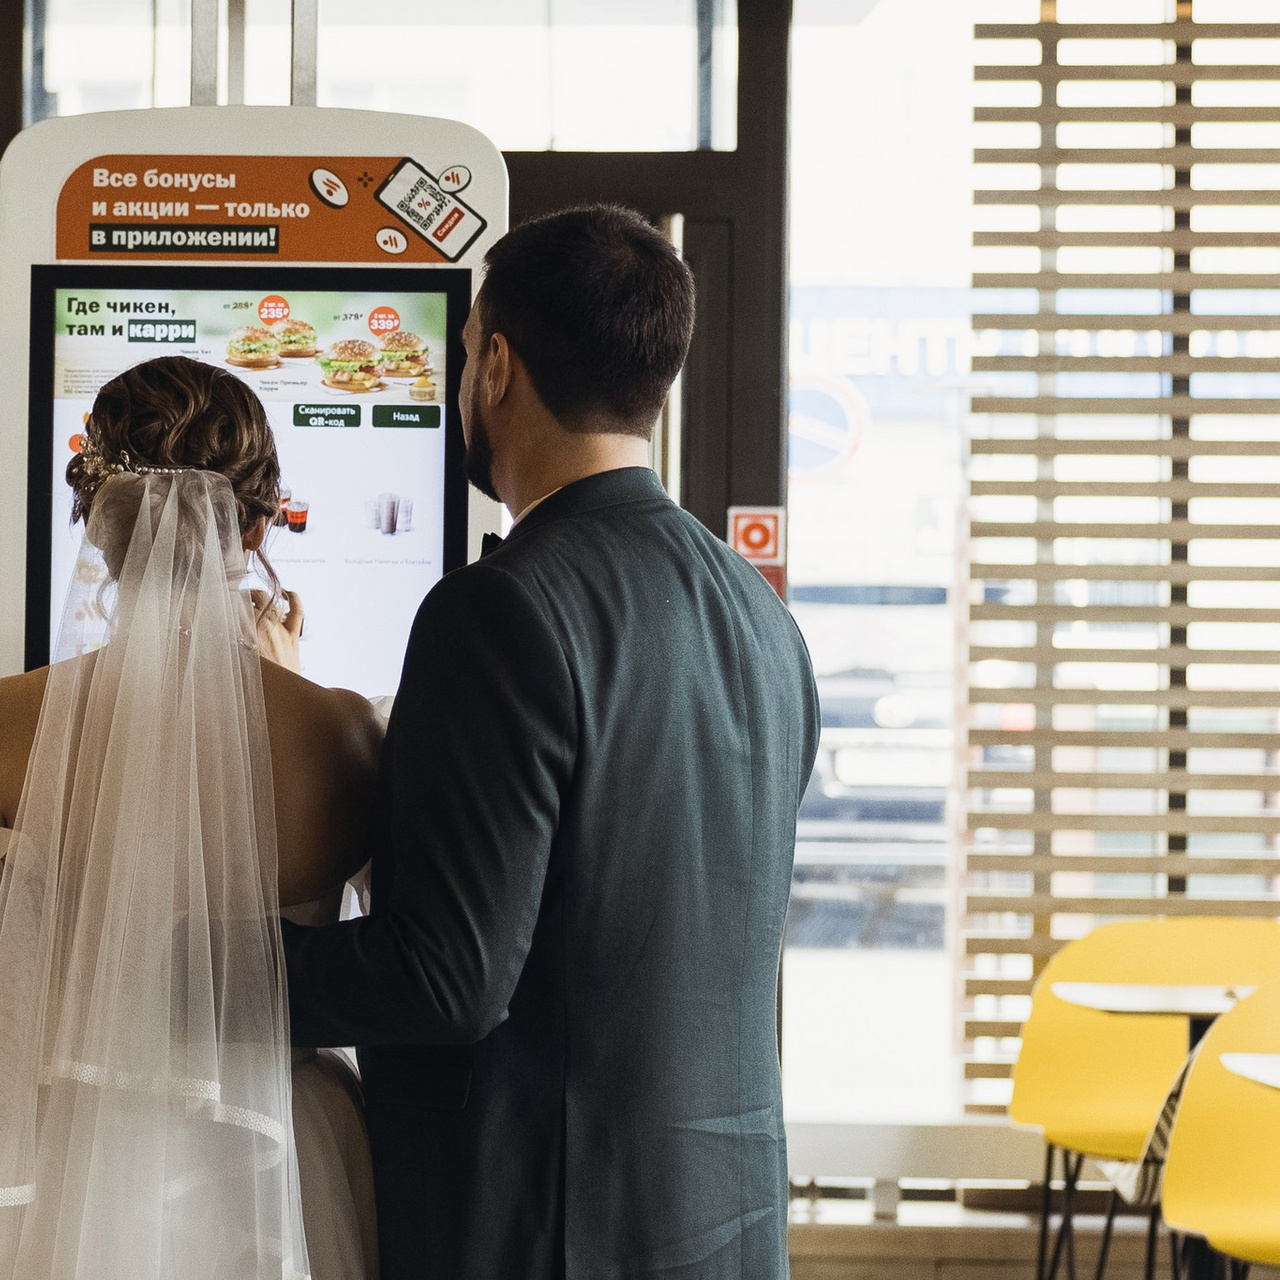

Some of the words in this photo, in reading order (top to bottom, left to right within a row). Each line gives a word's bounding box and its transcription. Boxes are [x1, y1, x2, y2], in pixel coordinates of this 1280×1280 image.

[92, 168, 138, 188] Все
[143, 168, 236, 193] бонусы
[92, 201, 107, 217] и
[112, 201, 190, 220] акции
[224, 202, 310, 219] только
[92, 230, 107, 245] в
[112, 227, 277, 250] приложении!
[67, 297, 100, 316] Где
[106, 301, 176, 317] чикен,
[66, 324, 105, 336] там
[112, 325, 124, 336] и
[129, 323, 195, 342] карри
[298, 405, 356, 416] Сканировать
[393, 411, 420, 422] Назад
[309, 417, 345, 427] QR-код
